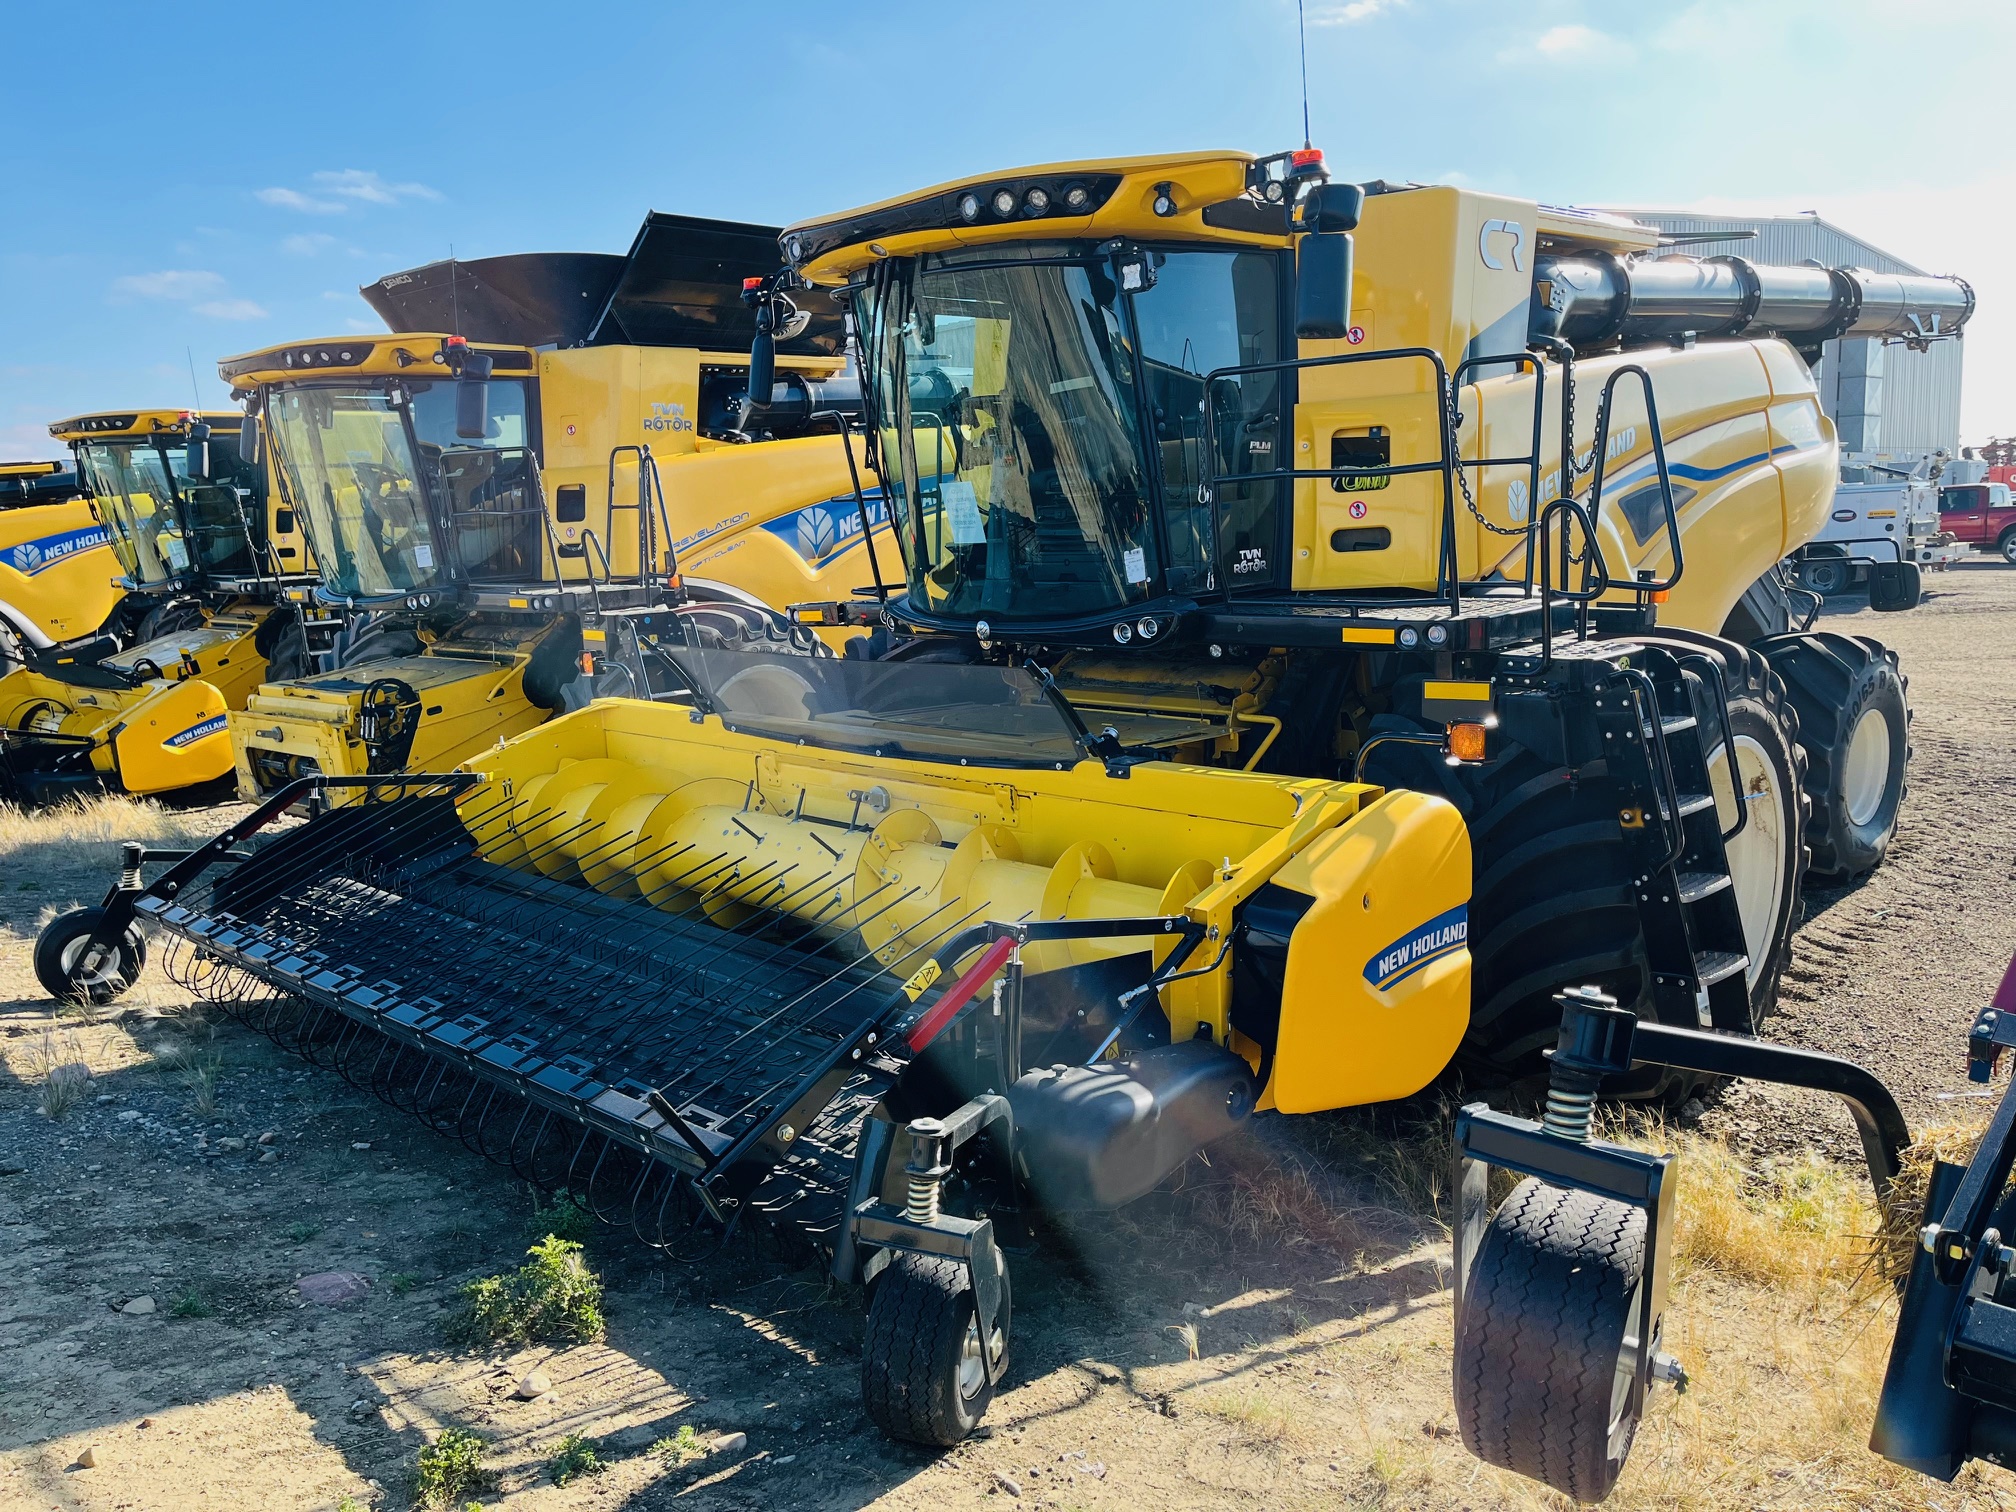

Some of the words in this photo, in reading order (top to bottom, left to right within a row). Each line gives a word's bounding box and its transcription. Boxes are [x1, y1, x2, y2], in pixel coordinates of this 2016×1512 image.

[1479, 219, 1525, 272] CR
[383, 274, 412, 289] DEMCO
[643, 415, 693, 432] ROTOR
[1250, 441, 1271, 450] PLM
[672, 511, 750, 549] REVELATION
[44, 541, 73, 560] NEW
[690, 540, 746, 571] OPTI-CLEAN
[1233, 559, 1267, 574] ROTOR
[173, 732, 193, 745] NEW
[1379, 945, 1409, 977] NEW
[1412, 922, 1466, 958] HOLLAND
